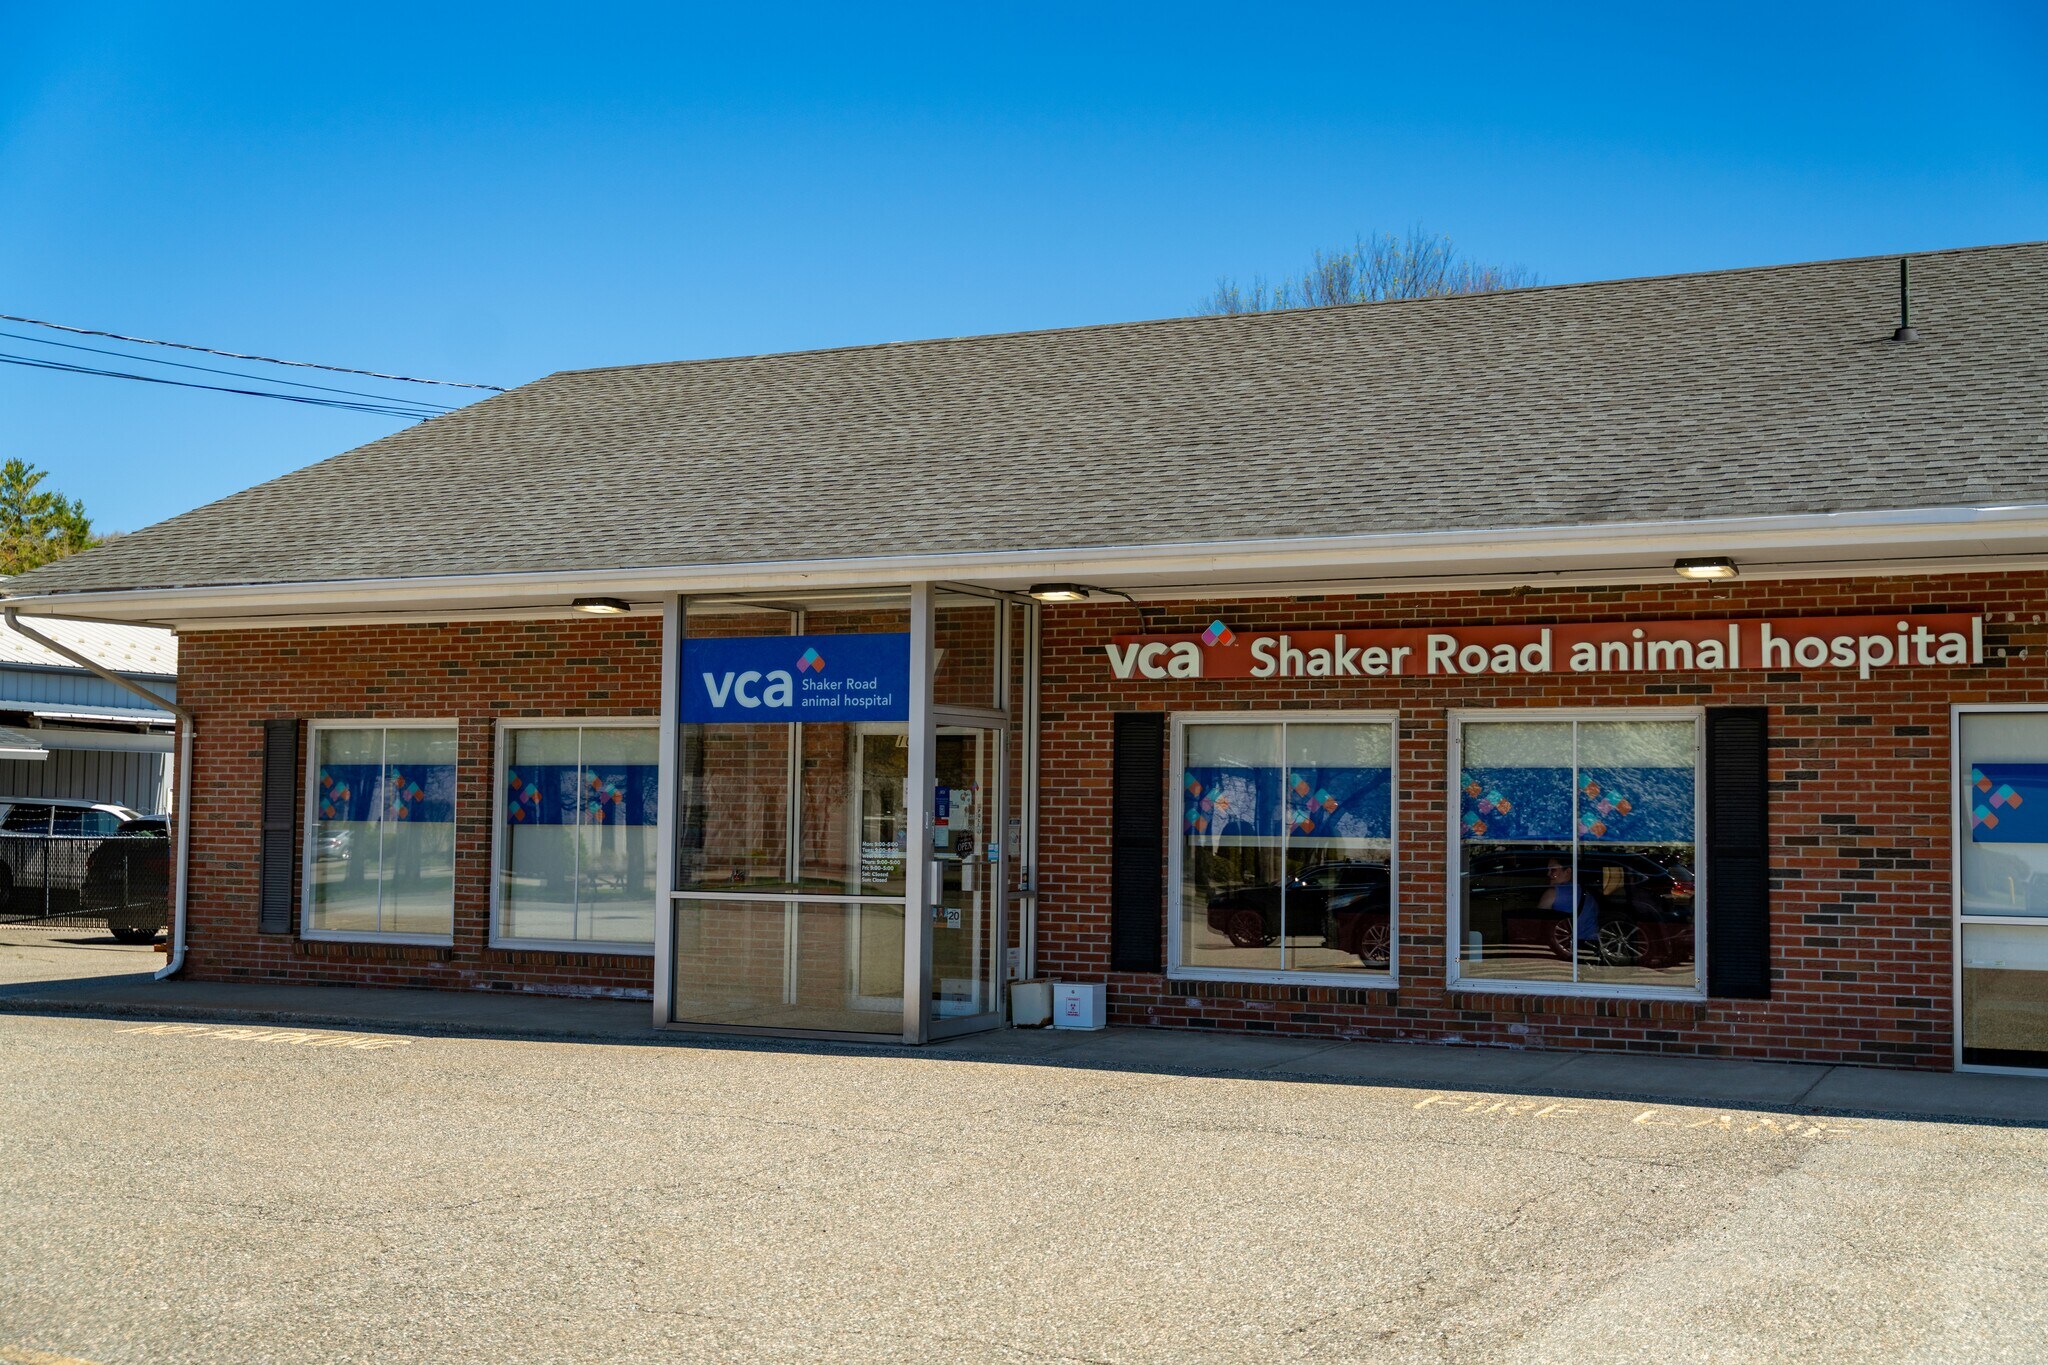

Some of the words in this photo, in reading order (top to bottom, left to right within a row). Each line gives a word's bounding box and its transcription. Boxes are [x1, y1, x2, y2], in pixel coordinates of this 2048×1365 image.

[1105, 638, 1203, 679] vca
[1249, 634, 1412, 677] Shaker
[1427, 628, 1553, 675] Road
[1570, 623, 1739, 672] animal
[1761, 616, 1984, 680] hospital
[702, 669, 794, 708] vca
[801, 678, 842, 690] Shaker
[847, 677, 877, 690] Road
[801, 695, 840, 707] animal
[845, 693, 892, 708] hospital
[957, 841, 973, 852] OPEN
[948, 911, 960, 920] 20
[1413, 1094, 1592, 1119] FIRE
